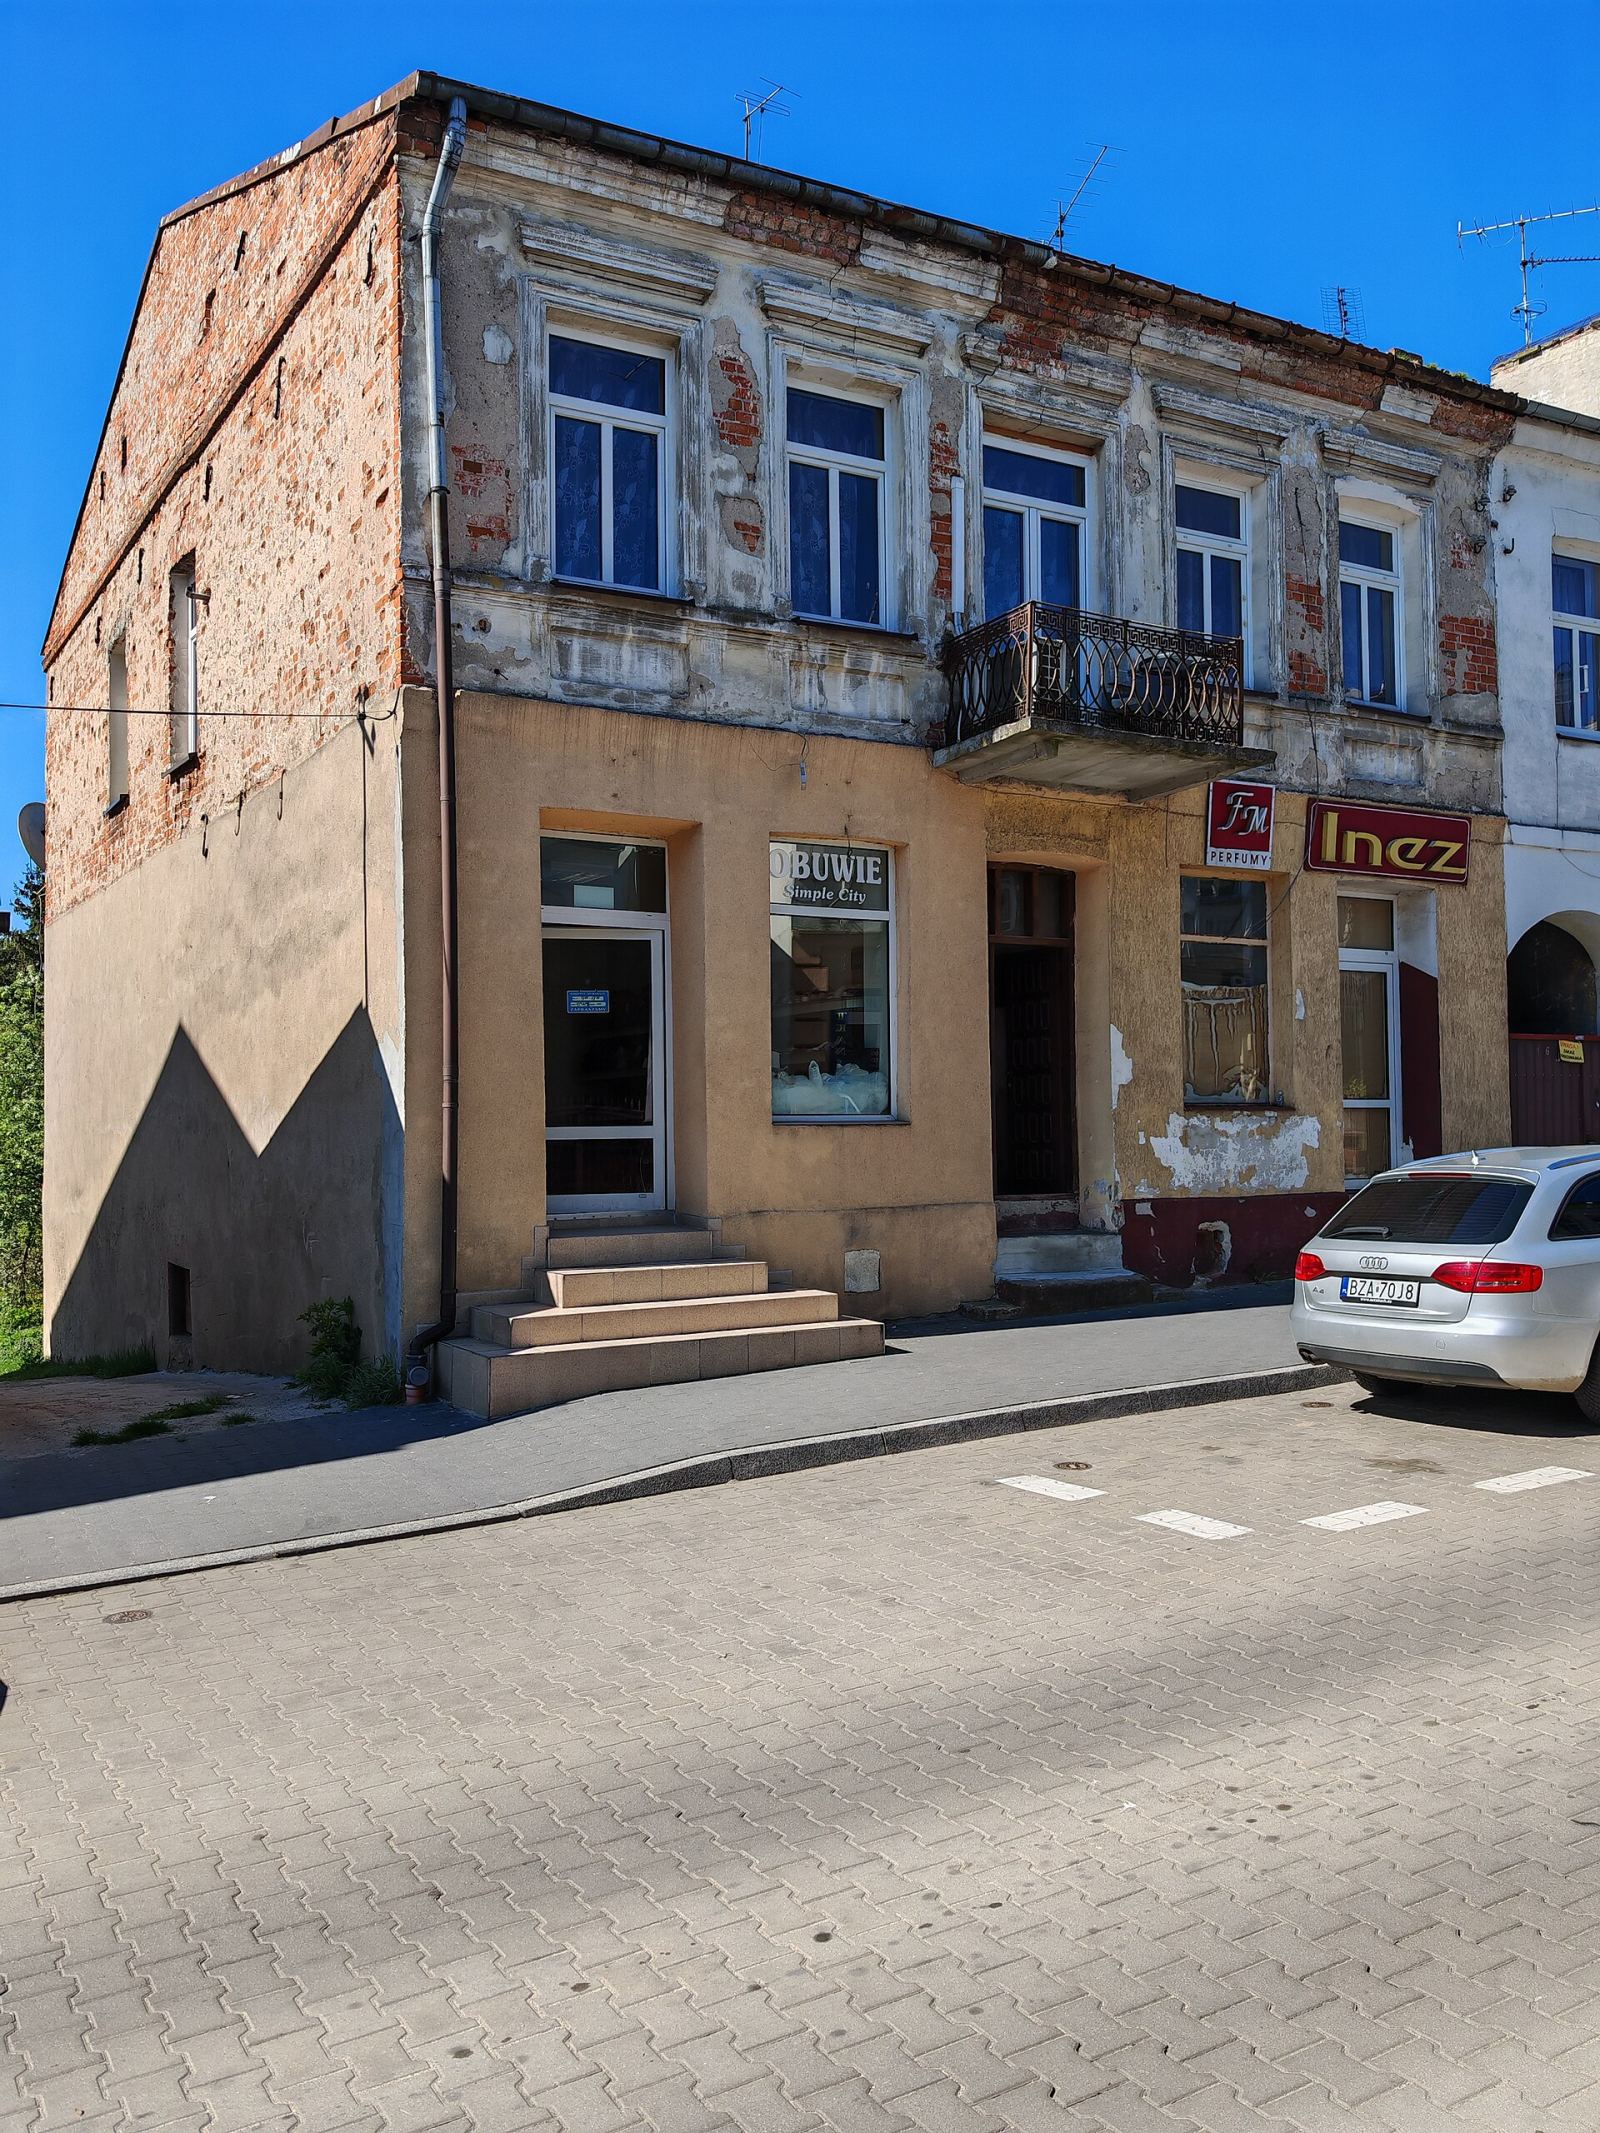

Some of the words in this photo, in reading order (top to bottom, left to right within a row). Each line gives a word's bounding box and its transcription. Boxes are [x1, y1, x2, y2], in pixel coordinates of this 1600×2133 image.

[1321, 811, 1467, 872] Inez
[769, 848, 882, 884] OBUWIE
[1210, 851, 1267, 866] PERFUMY
[783, 884, 834, 902] Simple
[838, 888, 866, 905] City
[1350, 1279, 1373, 1297] BZA
[1379, 1281, 1414, 1300] 70J8
